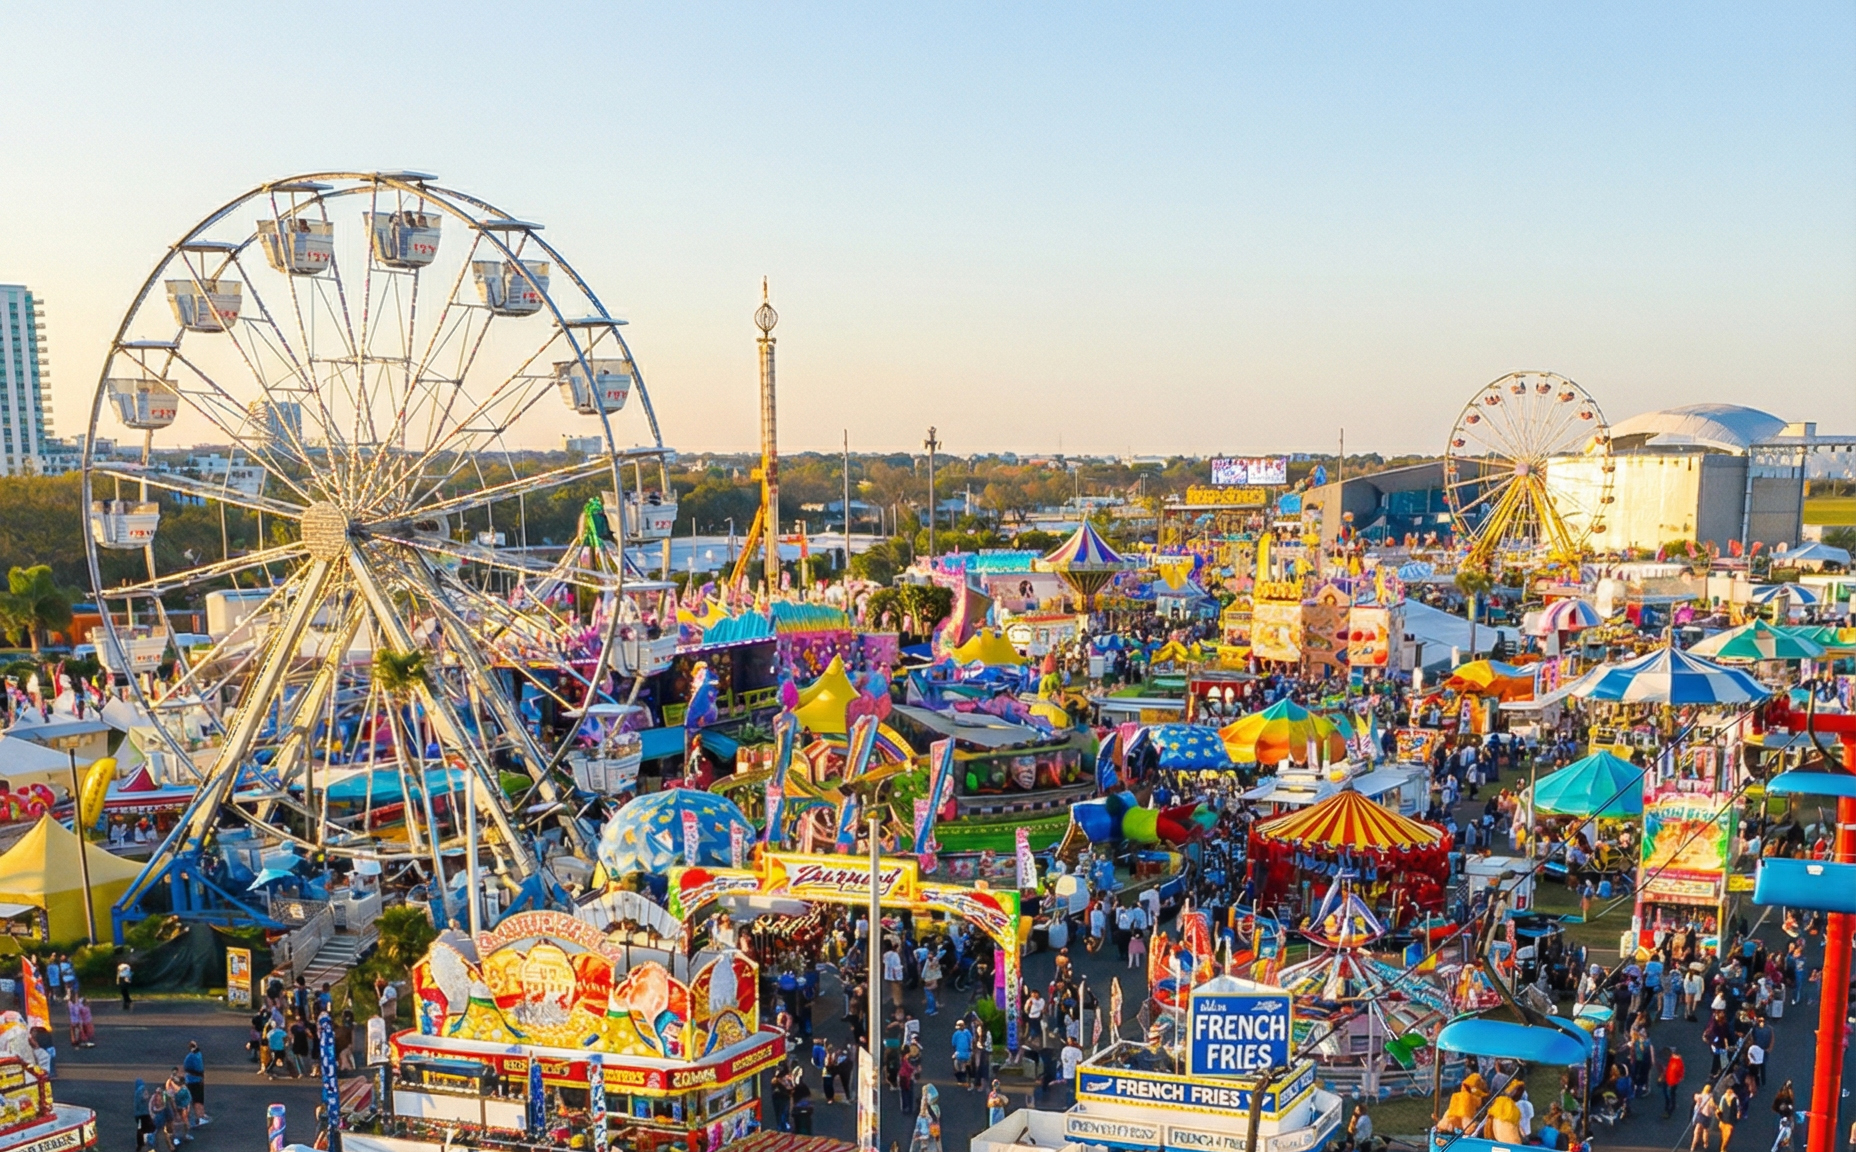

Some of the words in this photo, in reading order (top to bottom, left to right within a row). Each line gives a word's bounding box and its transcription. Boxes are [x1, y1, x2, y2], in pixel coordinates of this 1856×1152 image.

[1196, 1014, 1286, 1041] FRENCH
[1207, 1044, 1272, 1069] FRIES
[1116, 1078, 1184, 1102] FRENCH
[1191, 1086, 1240, 1108] FRIES
